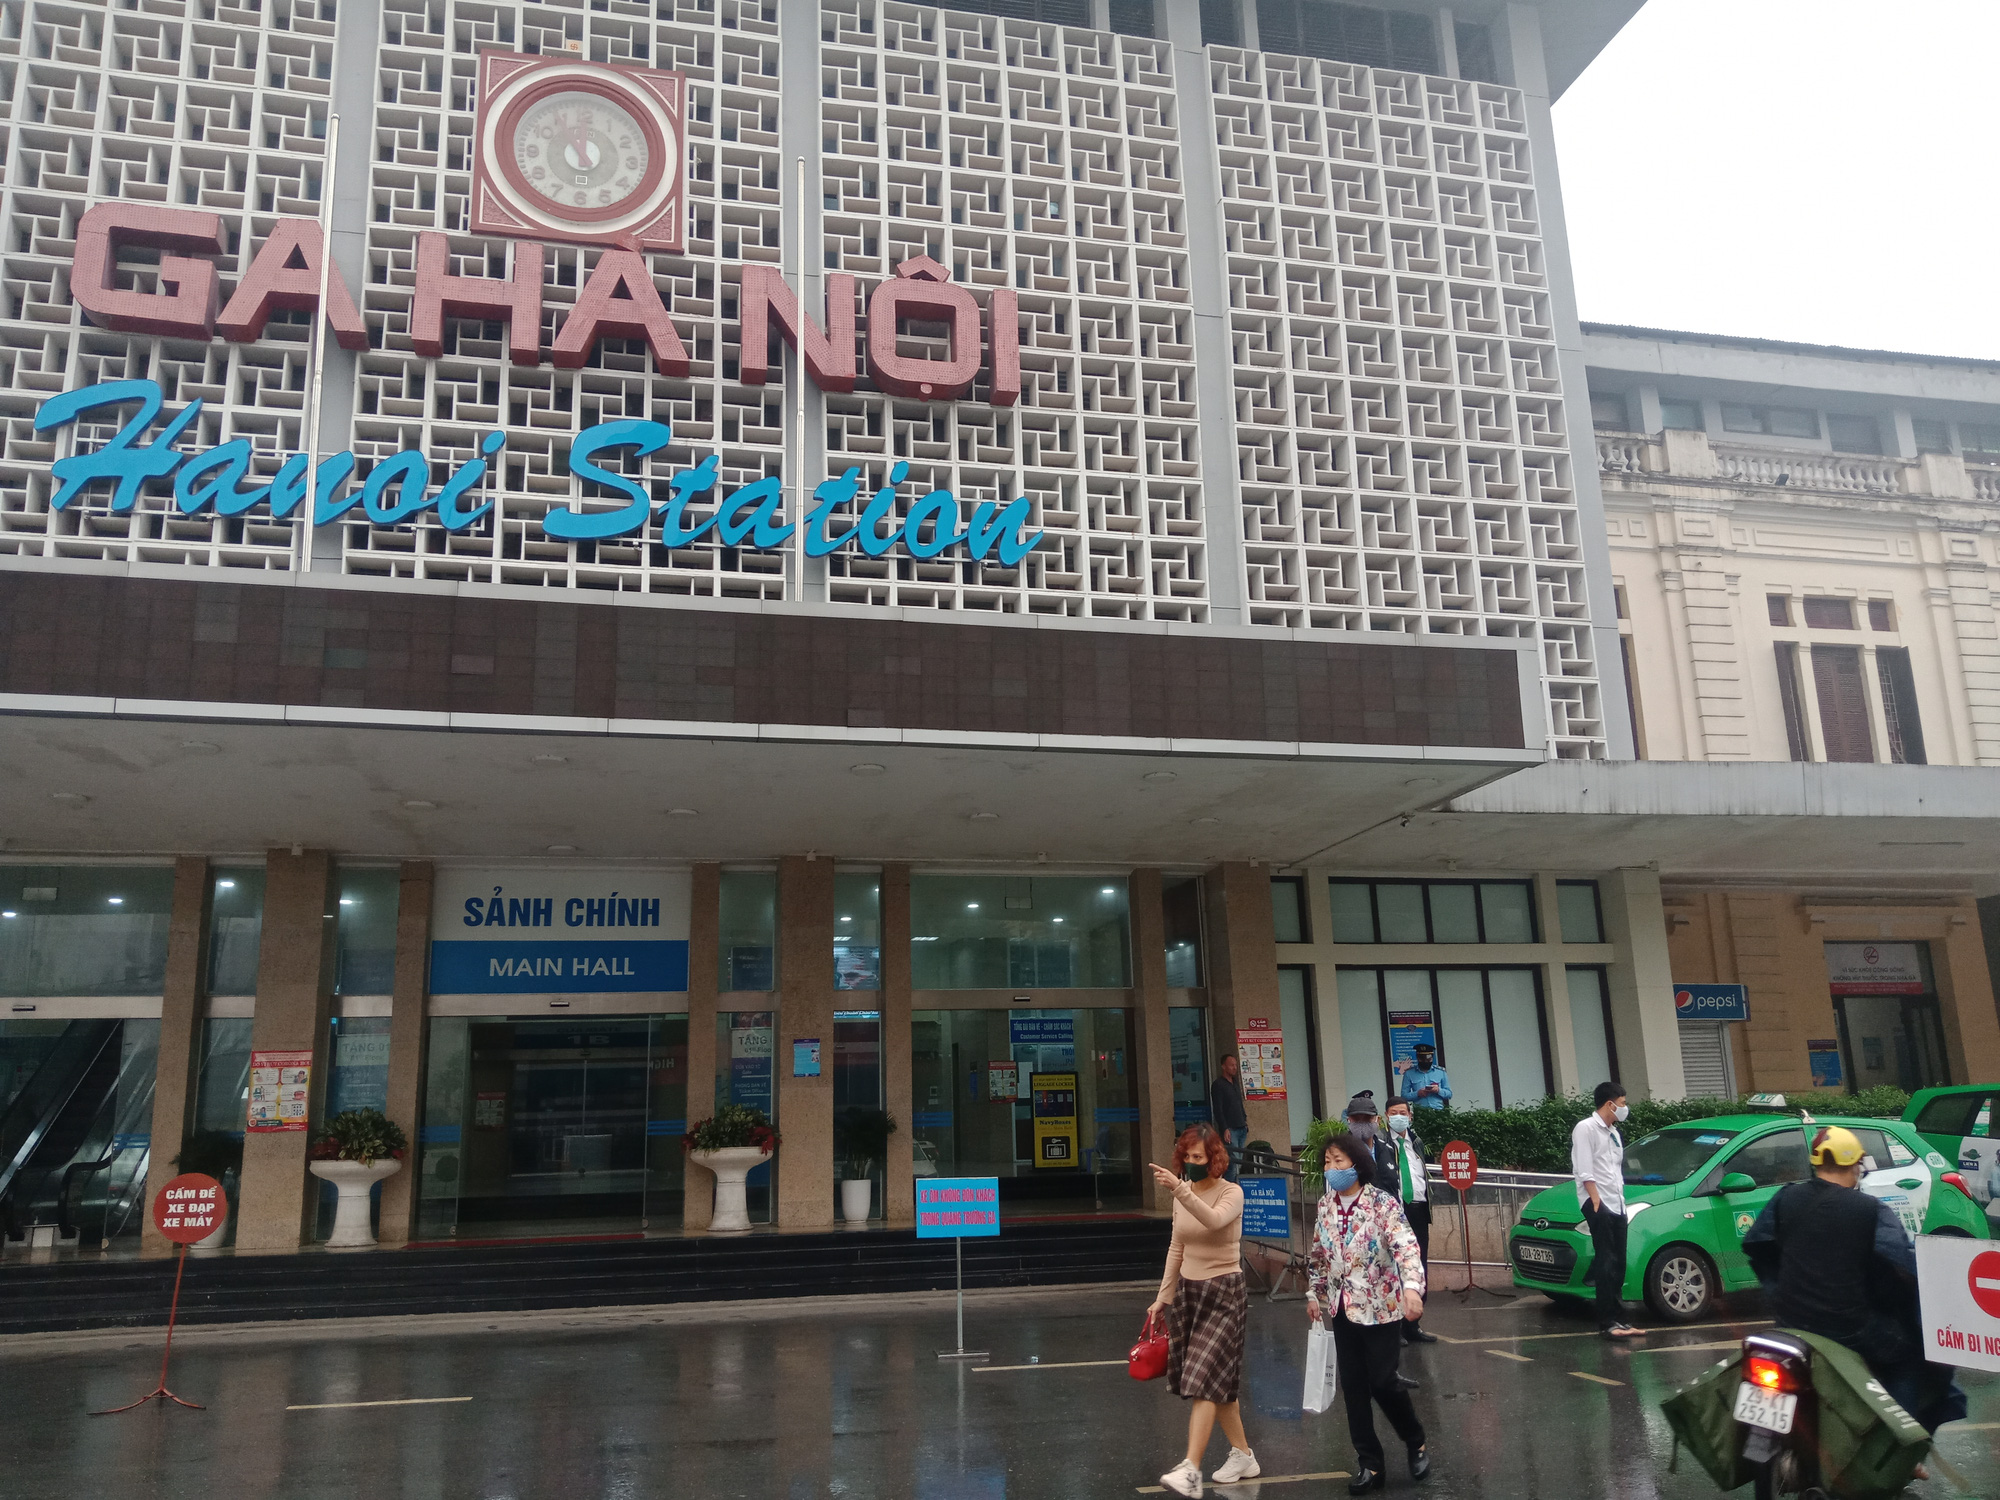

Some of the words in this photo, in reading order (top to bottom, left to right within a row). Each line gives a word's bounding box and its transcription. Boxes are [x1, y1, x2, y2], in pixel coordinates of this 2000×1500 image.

[70, 201, 371, 352] GA
[411, 231, 690, 378] HÀ
[740, 253, 1021, 407] NỘI
[33, 378, 506, 533] Hanoi
[542, 419, 1043, 568] Station
[463, 886, 553, 927] SẢNH
[564, 891, 661, 927] CHÍNH
[489, 957, 563, 977] MAIN
[572, 957, 635, 976] HALL
[1697, 994, 1736, 1010] pepsi
[1447, 1150, 1460, 1160] CẤM
[166, 1187, 196, 1199] CẤM
[199, 1186, 218, 1198] ĐỂ
[167, 1204, 185, 1213] XE
[188, 1203, 215, 1214] ĐẠP
[163, 1218, 180, 1227] XE
[184, 1215, 213, 1227] MÁY
[1937, 1324, 1964, 1350] CẤM
[1968, 1333, 1981, 1353] ĐI
[1739, 1403, 1788, 1430] 252.15
